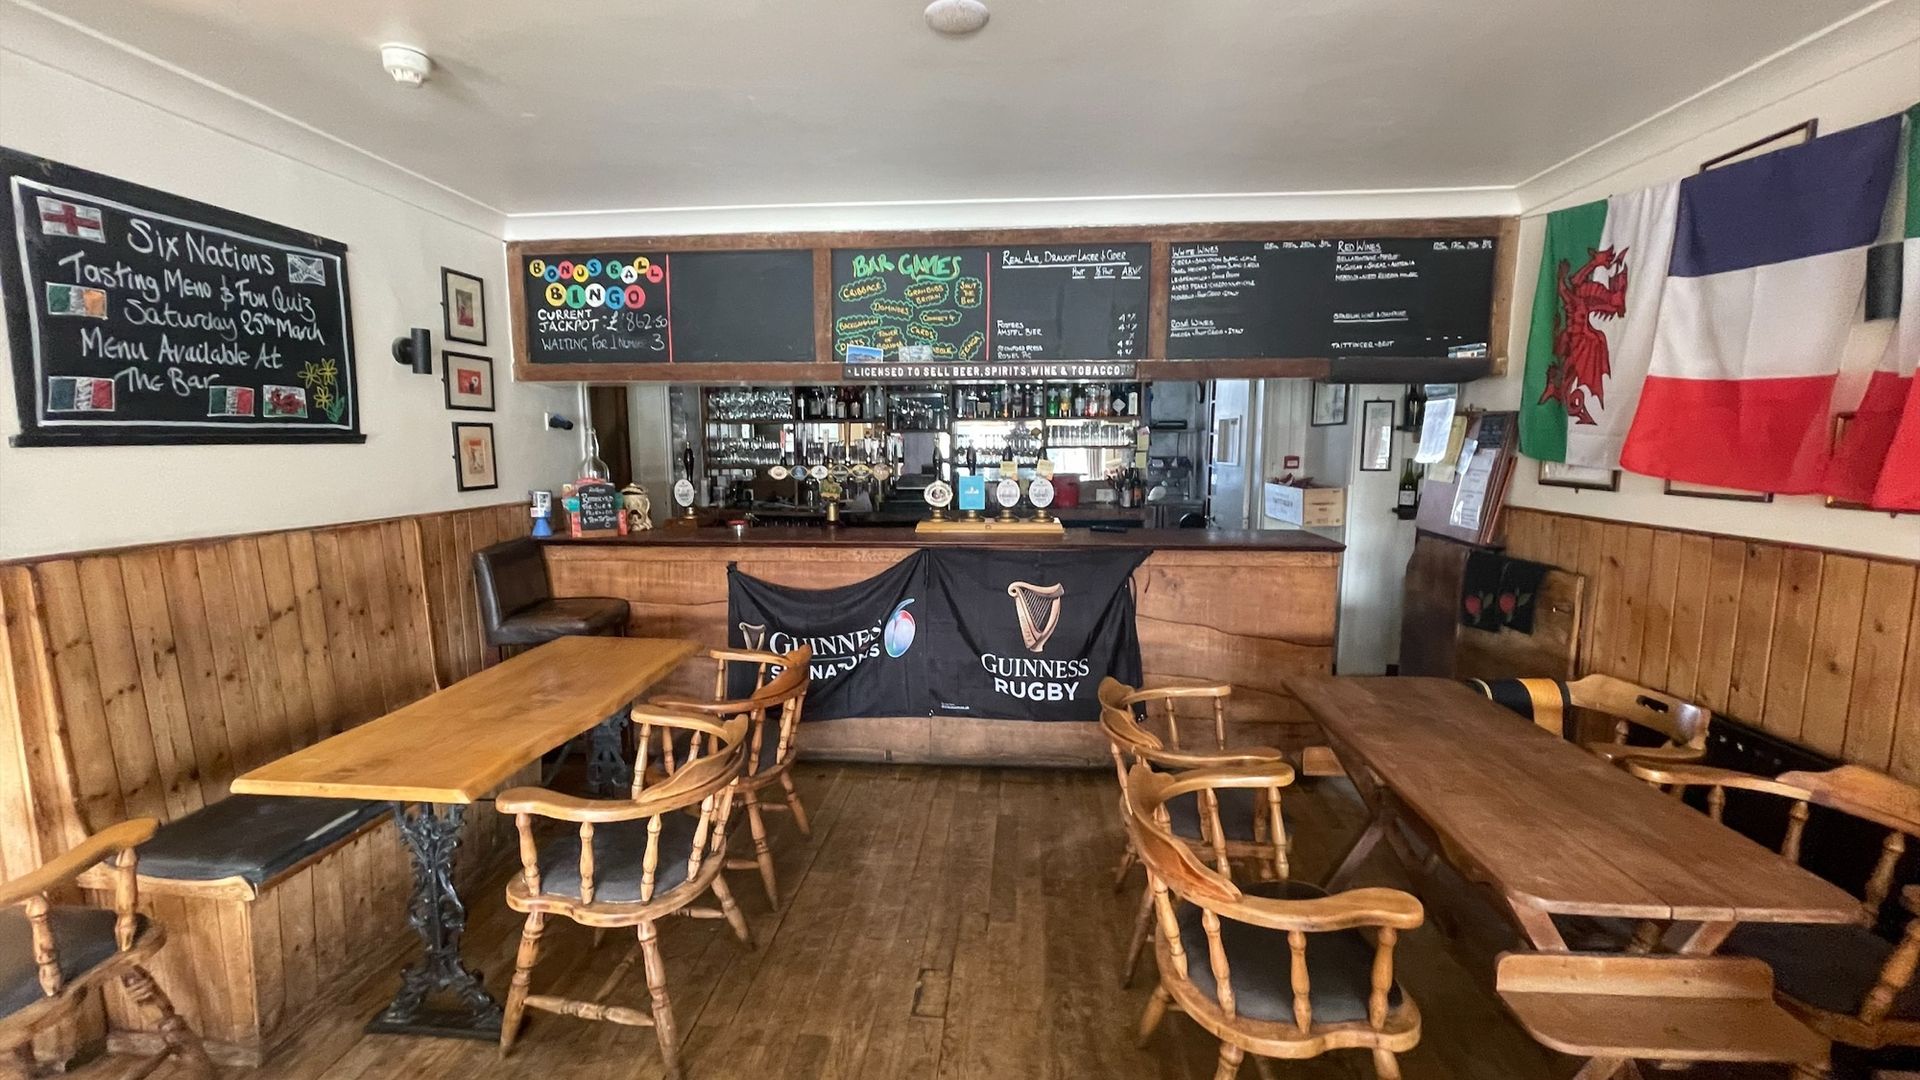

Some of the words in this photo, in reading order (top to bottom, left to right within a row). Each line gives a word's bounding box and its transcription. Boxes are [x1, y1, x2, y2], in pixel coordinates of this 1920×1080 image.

[127, 218, 179, 262] Six
[185, 231, 275, 276] Nations
[1337, 240, 1355, 252] RED
[1356, 240, 1381, 252] WINES
[532, 260, 600, 281] BONUS
[609, 260, 661, 281] BALL
[852, 254, 895, 278] BAR
[898, 253, 962, 279] GAMES
[1121, 265, 1142, 276] ABV
[58, 250, 161, 303] Tasting
[164, 268, 212, 298] Menu
[220, 274, 235, 311] &
[235, 279, 269, 309] Fun
[272, 285, 316, 323] Quiz
[549, 286, 641, 306] BINGO
[842, 281, 882, 298] CRIBBAGE
[124, 298, 237, 342] Saturday
[276, 317, 326, 346] March
[537, 308, 592, 320] CURRENT
[539, 318, 600, 333] JACKPOT
[80, 326, 149, 361] Menu
[158, 333, 250, 366] Available
[254, 342, 283, 370] At
[541, 337, 588, 351] WAITING
[650, 333, 665, 351] 3
[114, 366, 165, 392] The
[167, 366, 220, 397] Bar
[854, 366, 903, 377] LICENSED
[907, 366, 920, 377] TO
[923, 366, 949, 377] SELL
[1031, 366, 1058, 376] WINE
[1060, 366, 1068, 376] &
[981, 653, 1090, 679] GUINNESS
[994, 677, 1080, 701] RUGBY
